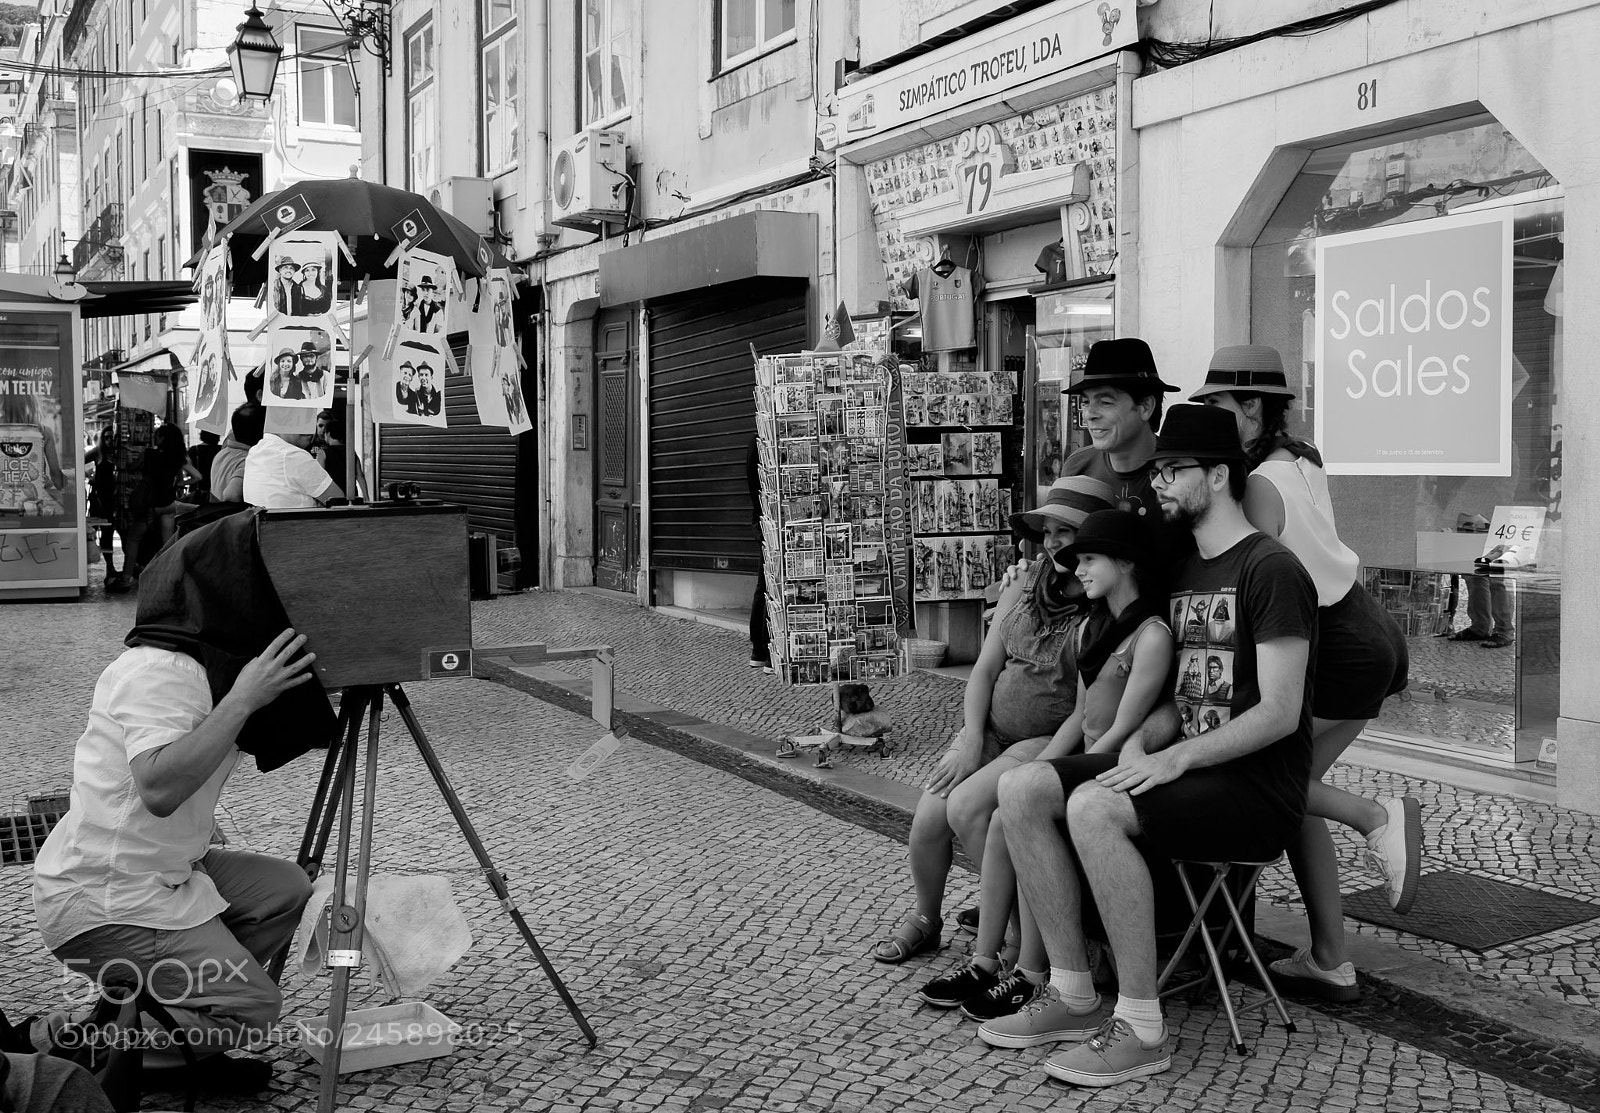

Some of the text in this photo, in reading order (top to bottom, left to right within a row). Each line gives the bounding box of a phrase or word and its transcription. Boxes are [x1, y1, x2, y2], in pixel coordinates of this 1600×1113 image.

[899, 32, 1062, 111] SIMPÁTICO TROFEU, LDA
[1357, 78, 1377, 111] 81
[964, 161, 992, 215] 79
[1329, 279, 1491, 340] Saldos
[19, 366, 53, 381] amigos
[1345, 344, 1471, 399] Sales
[12, 380, 53, 395] TETLEY
[2, 471, 31, 482] TEA
[4, 460, 29, 471] ICE
[889, 475, 903, 500] DA
[904, 497, 913, 546] EURO
[1494, 523, 1535, 541] 49 €
